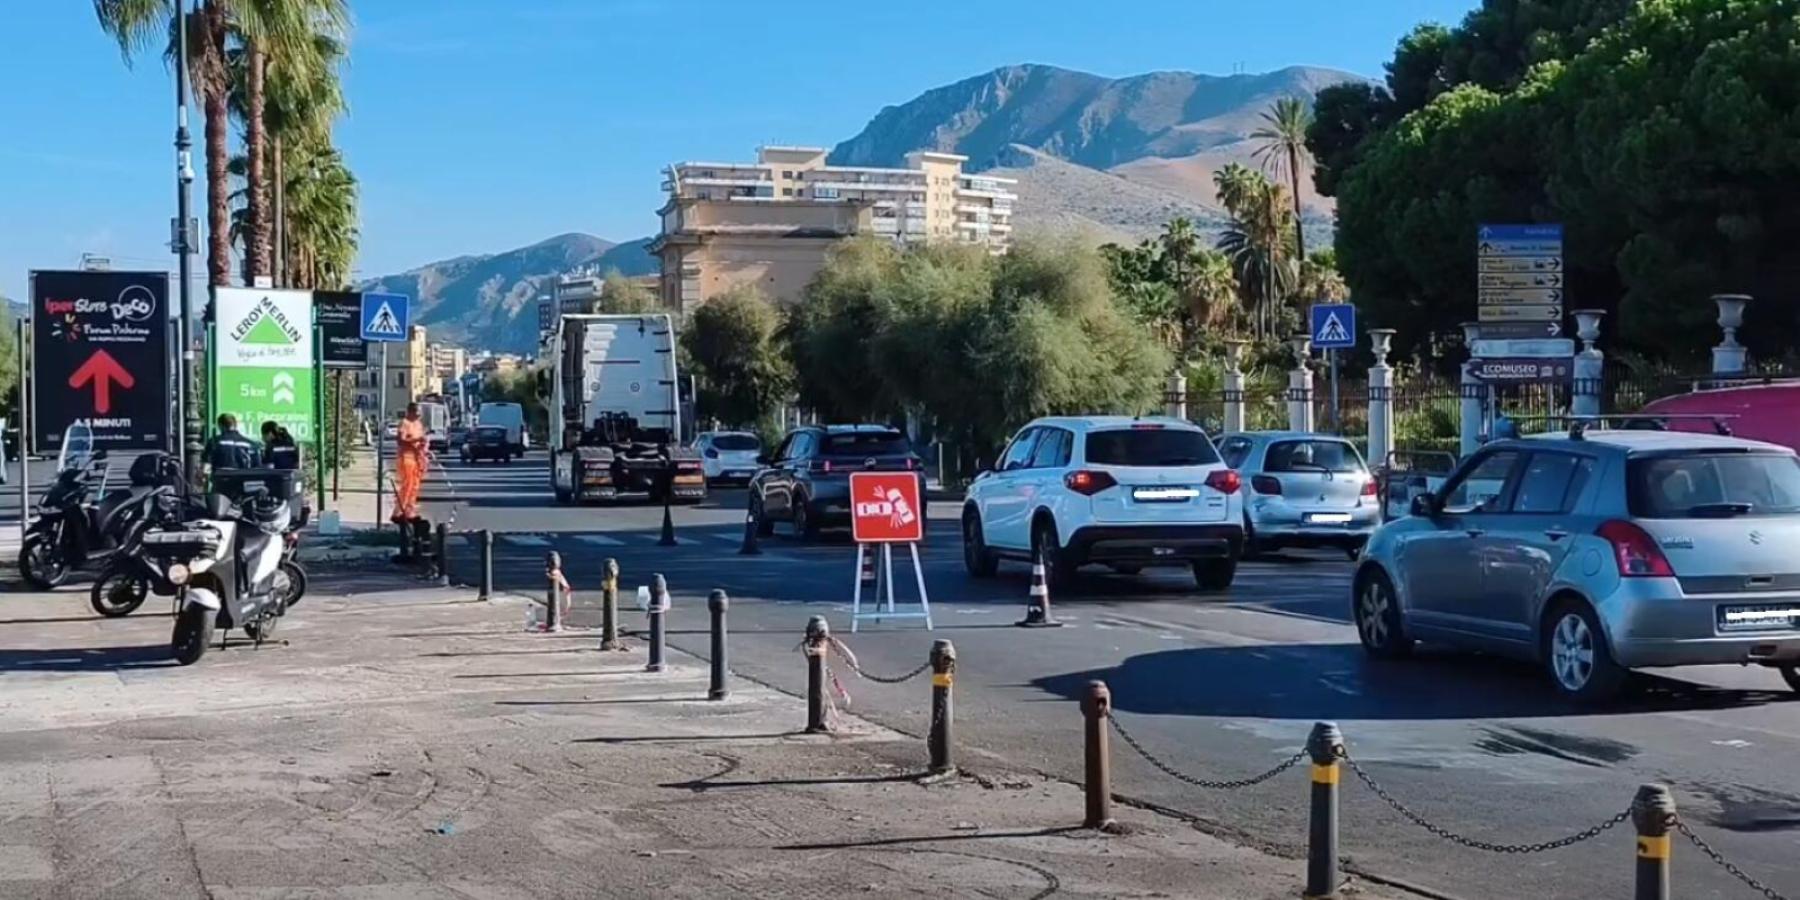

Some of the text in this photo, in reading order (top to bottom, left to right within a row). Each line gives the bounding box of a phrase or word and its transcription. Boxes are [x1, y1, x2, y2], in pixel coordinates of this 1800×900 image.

[229, 296, 303, 343] LEROY MERLIN
[1482, 364, 1538, 374] ECOMUSEO
[240, 383, 267, 397] 5 km
[93, 418, 132, 428] MINUTI
